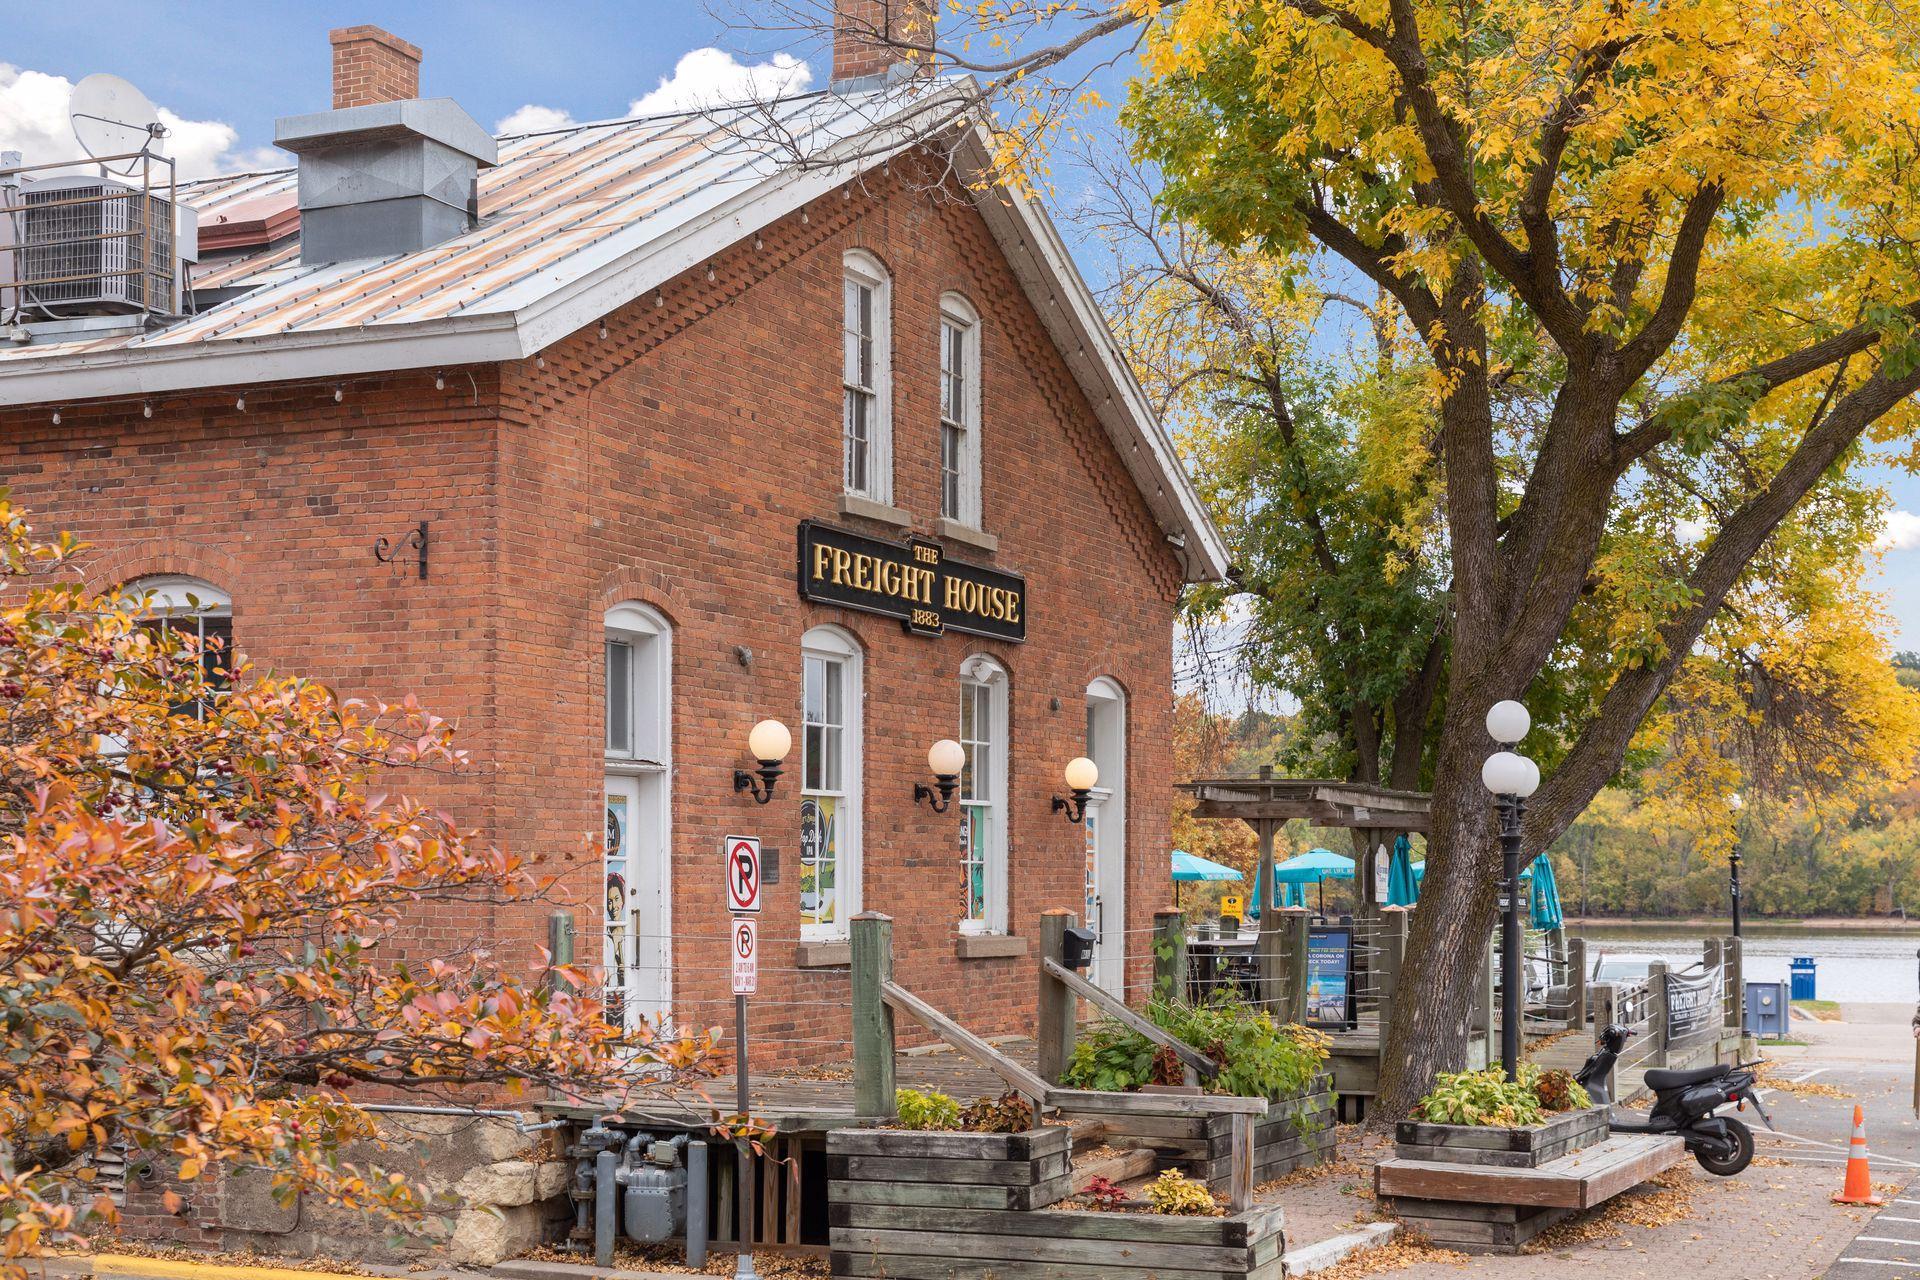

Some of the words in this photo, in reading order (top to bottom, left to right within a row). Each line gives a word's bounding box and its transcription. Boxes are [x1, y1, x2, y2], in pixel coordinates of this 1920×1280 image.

[914, 545, 938, 565] THE
[813, 543, 935, 604] FREIGHT
[943, 575, 1019, 623] HOUSE
[912, 609, 939, 627] 1883
